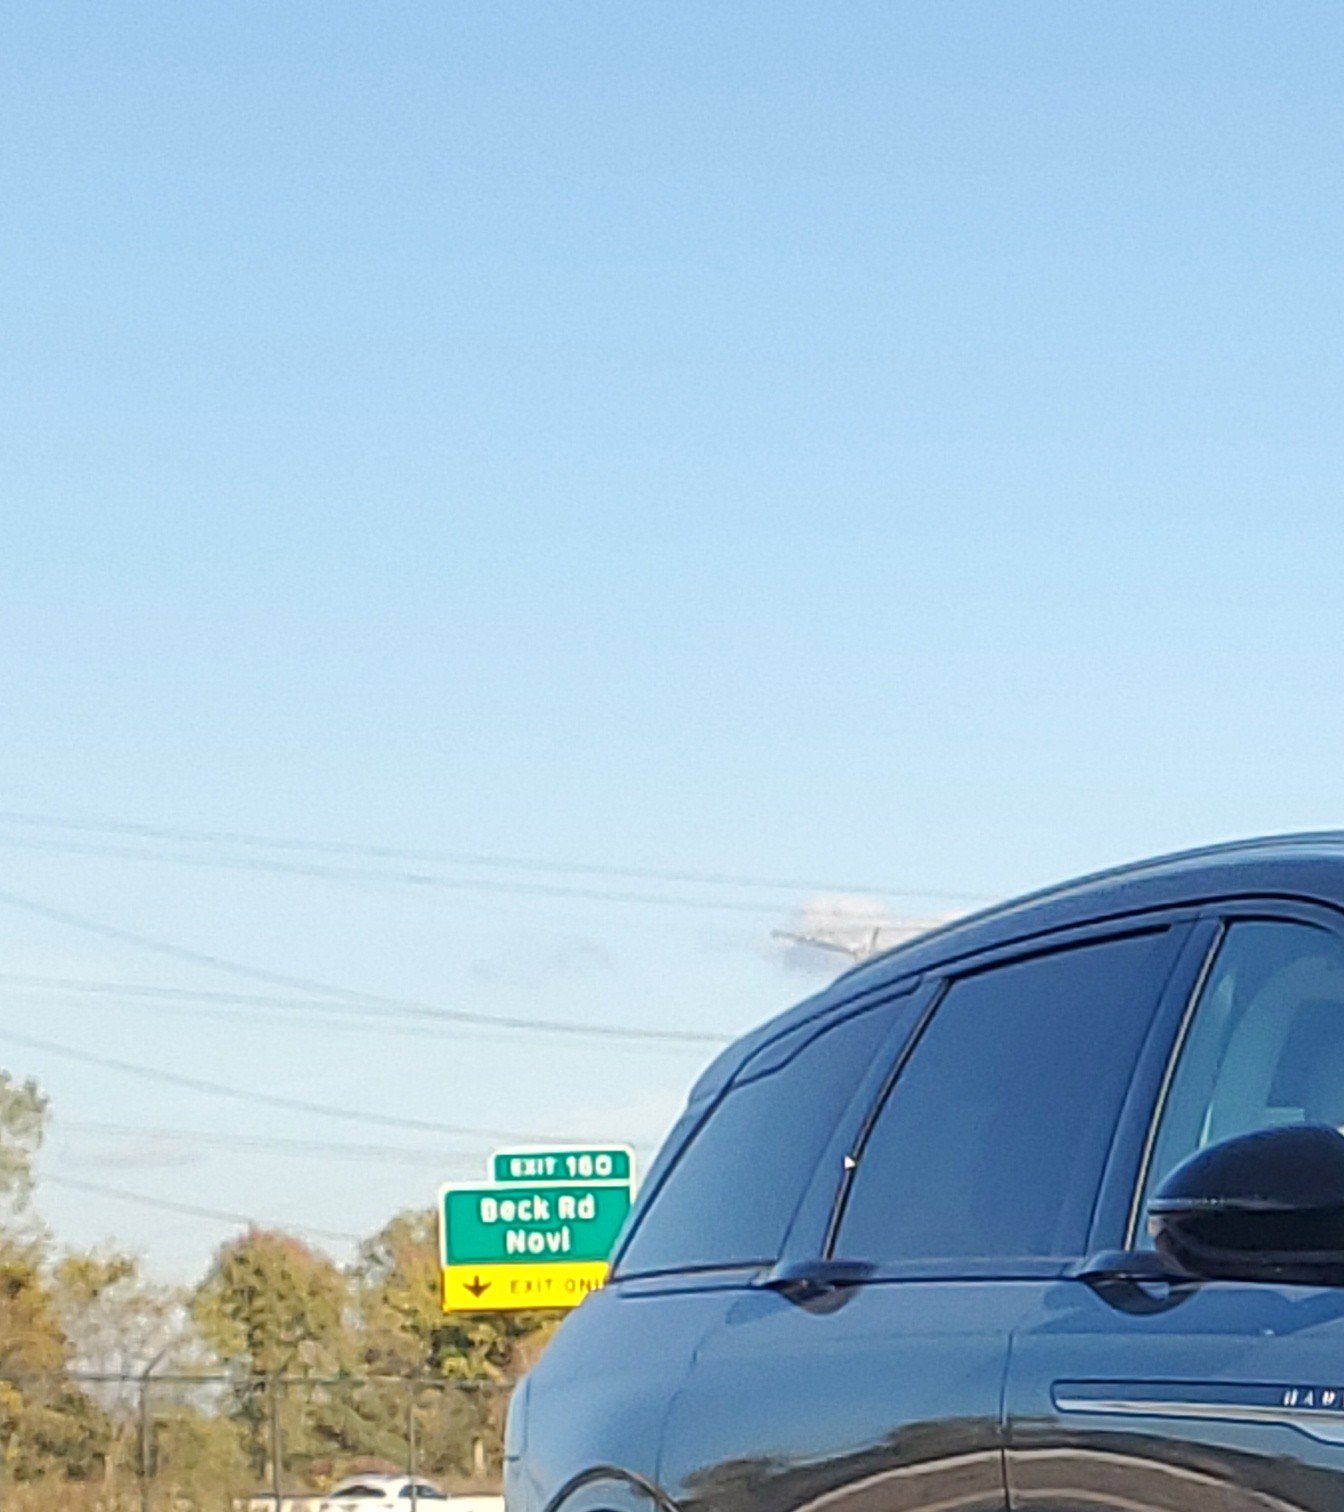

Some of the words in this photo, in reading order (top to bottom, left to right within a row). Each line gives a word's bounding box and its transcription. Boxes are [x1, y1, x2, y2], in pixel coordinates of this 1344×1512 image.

[510, 1157, 556, 1177] EXIT
[480, 1194, 550, 1223] Beck
[558, 1193, 595, 1219] Rd
[506, 1226, 570, 1254] Novi
[510, 1279, 553, 1294] EXIT
